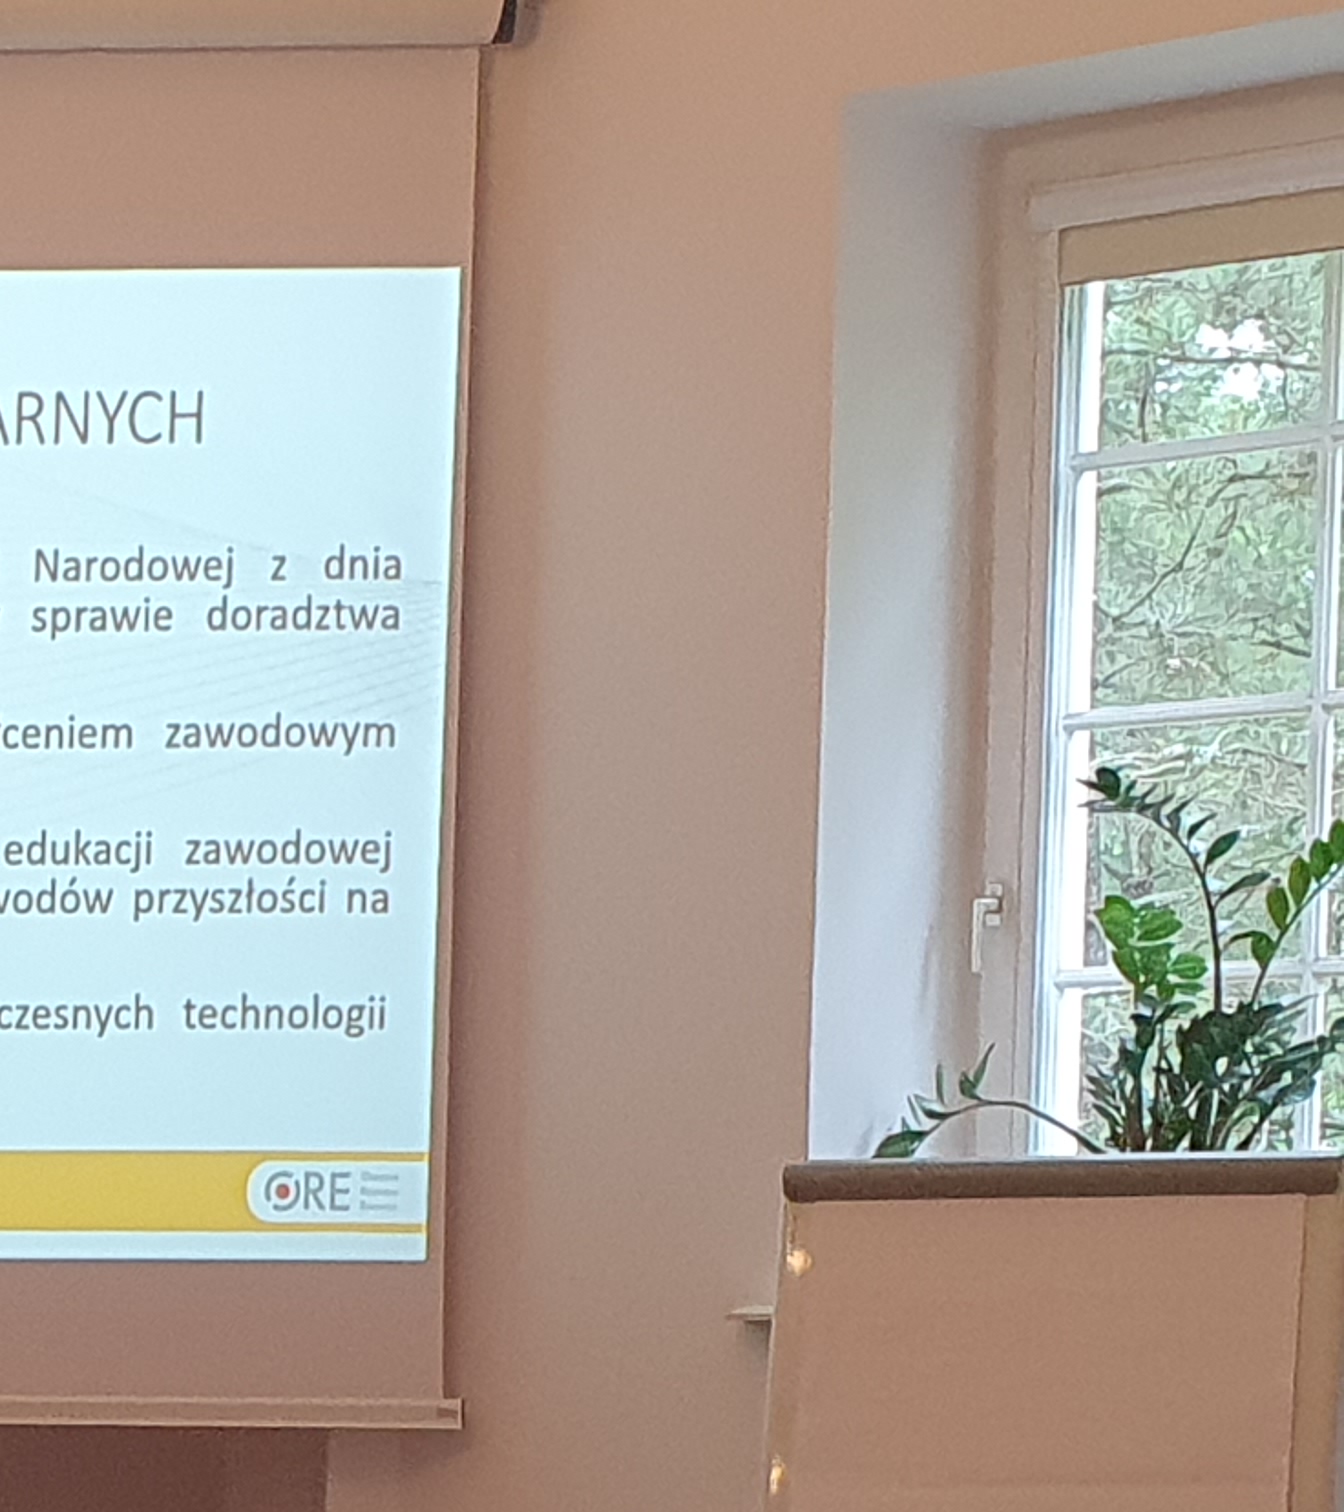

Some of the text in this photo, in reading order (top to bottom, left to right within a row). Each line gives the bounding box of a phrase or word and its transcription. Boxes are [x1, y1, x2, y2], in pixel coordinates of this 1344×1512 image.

[34, 544, 234, 590] Narodowej
[270, 554, 287, 582] z
[324, 543, 402, 581] dnia
[31, 596, 174, 641] sprawie
[206, 593, 400, 632] doradztwa
[164, 711, 396, 757] zawodowym
[3, 828, 153, 874] edukacji
[184, 828, 392, 875] zawodowej
[130, 876, 327, 923] przyszłości
[346, 888, 389, 914] na
[182, 992, 387, 1039] technologii
[264, 1170, 352, 1212] ORE
